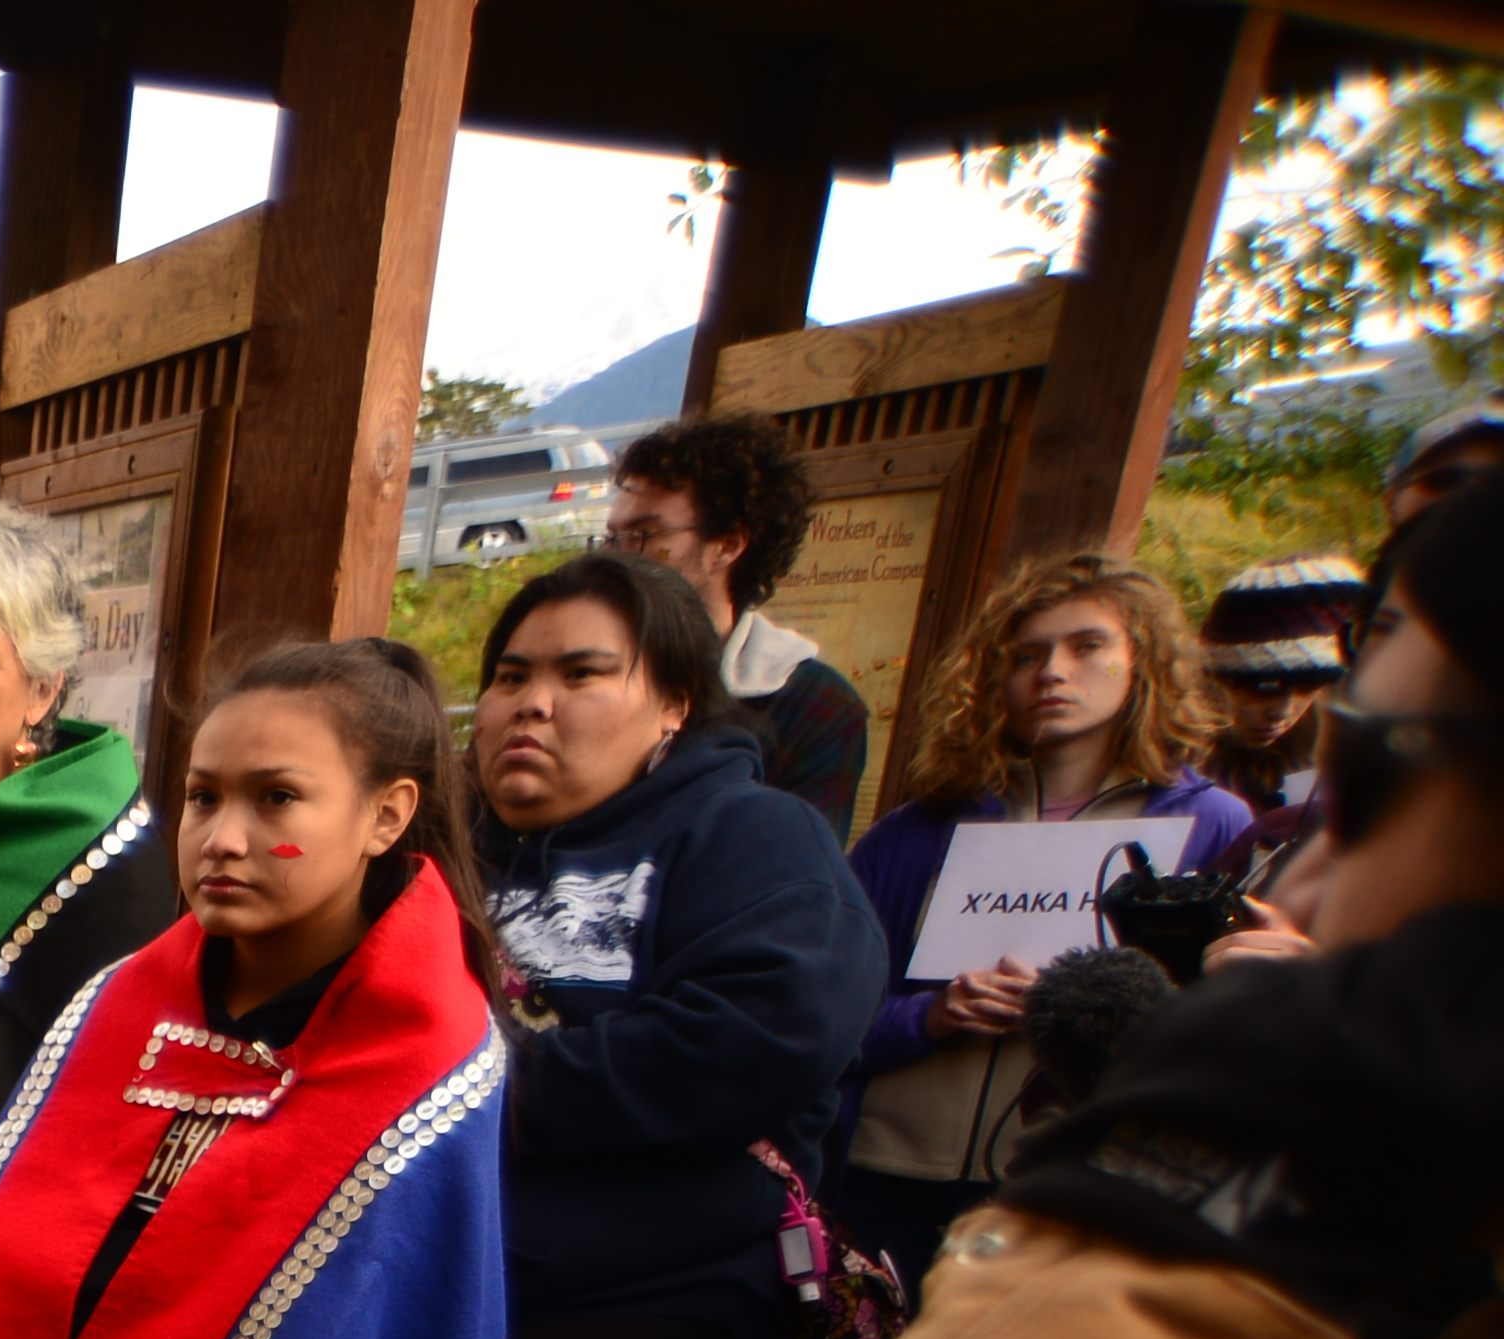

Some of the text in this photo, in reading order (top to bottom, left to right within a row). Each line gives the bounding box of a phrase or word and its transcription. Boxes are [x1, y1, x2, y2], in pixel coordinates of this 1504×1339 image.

[811, 508, 914, 550] Workers of the
[104, 600, 145, 664] Day
[960, 891, 1068, 914] X'AAKA
